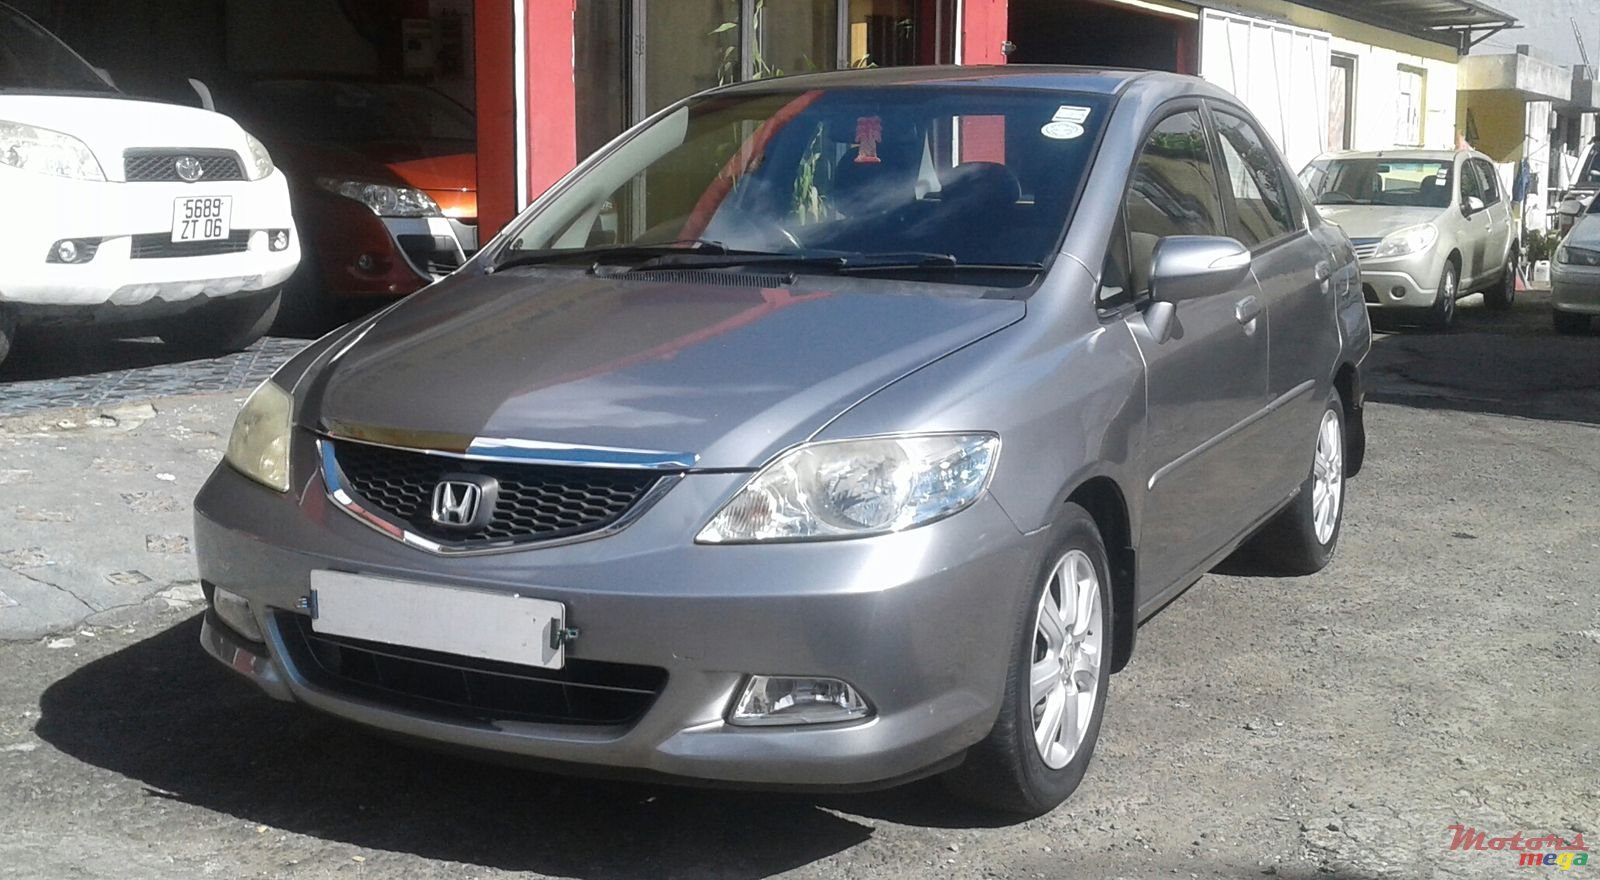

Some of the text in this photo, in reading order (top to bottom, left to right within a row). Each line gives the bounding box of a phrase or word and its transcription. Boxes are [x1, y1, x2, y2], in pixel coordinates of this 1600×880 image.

[185, 198, 222, 219] 5689
[181, 218, 223, 240] ZT 06
